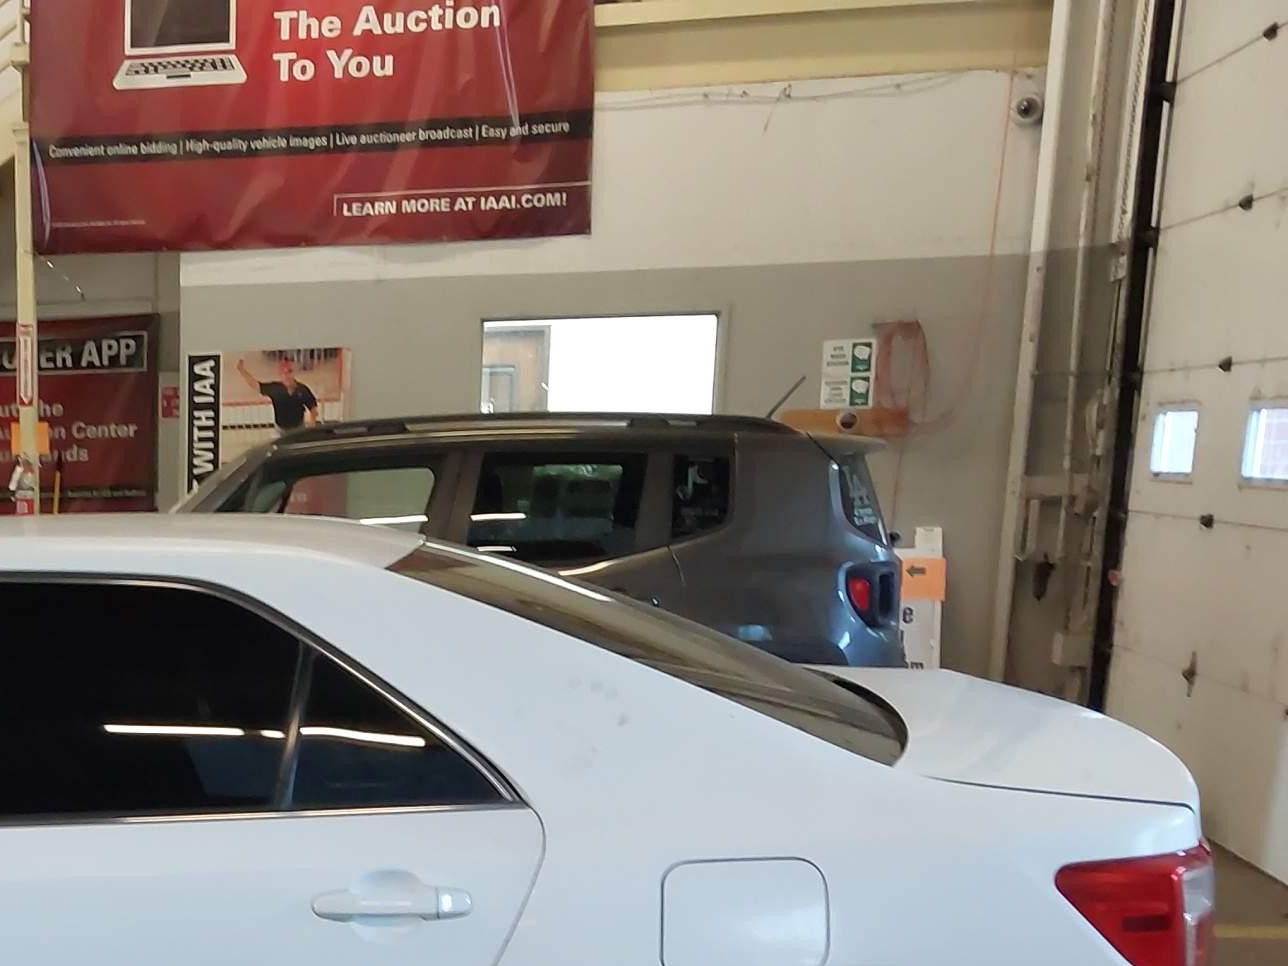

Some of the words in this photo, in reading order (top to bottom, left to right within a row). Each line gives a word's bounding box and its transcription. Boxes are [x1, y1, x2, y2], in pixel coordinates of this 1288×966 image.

[273, 10, 342, 42] The
[353, 1, 501, 37] Auction
[271, 51, 316, 82] To
[326, 48, 394, 80] You
[48, 143, 105, 158] Convenient
[106, 143, 138, 156] online
[139, 141, 178, 156] bidding
[185, 137, 249, 154] High-quality
[250, 135, 288, 150] vehicle
[289, 133, 328, 150] images
[335, 131, 358, 147] Live
[359, 131, 417, 145] auctioneer
[418, 124, 474, 141] broadcast
[481, 123, 508, 140] Easy
[509, 122, 529, 137] and
[531, 121, 570, 136] secure
[343, 199, 397, 217] LEARN
[401, 197, 451, 214] MORE
[454, 196, 477, 212] AT
[480, 191, 568, 211] IAAI.COM!
[80, 337, 137, 368] APP
[192, 359, 216, 403] IAA
[38, 400, 64, 418] he
[71, 421, 138, 439] Center
[192, 409, 215, 475] WITH
